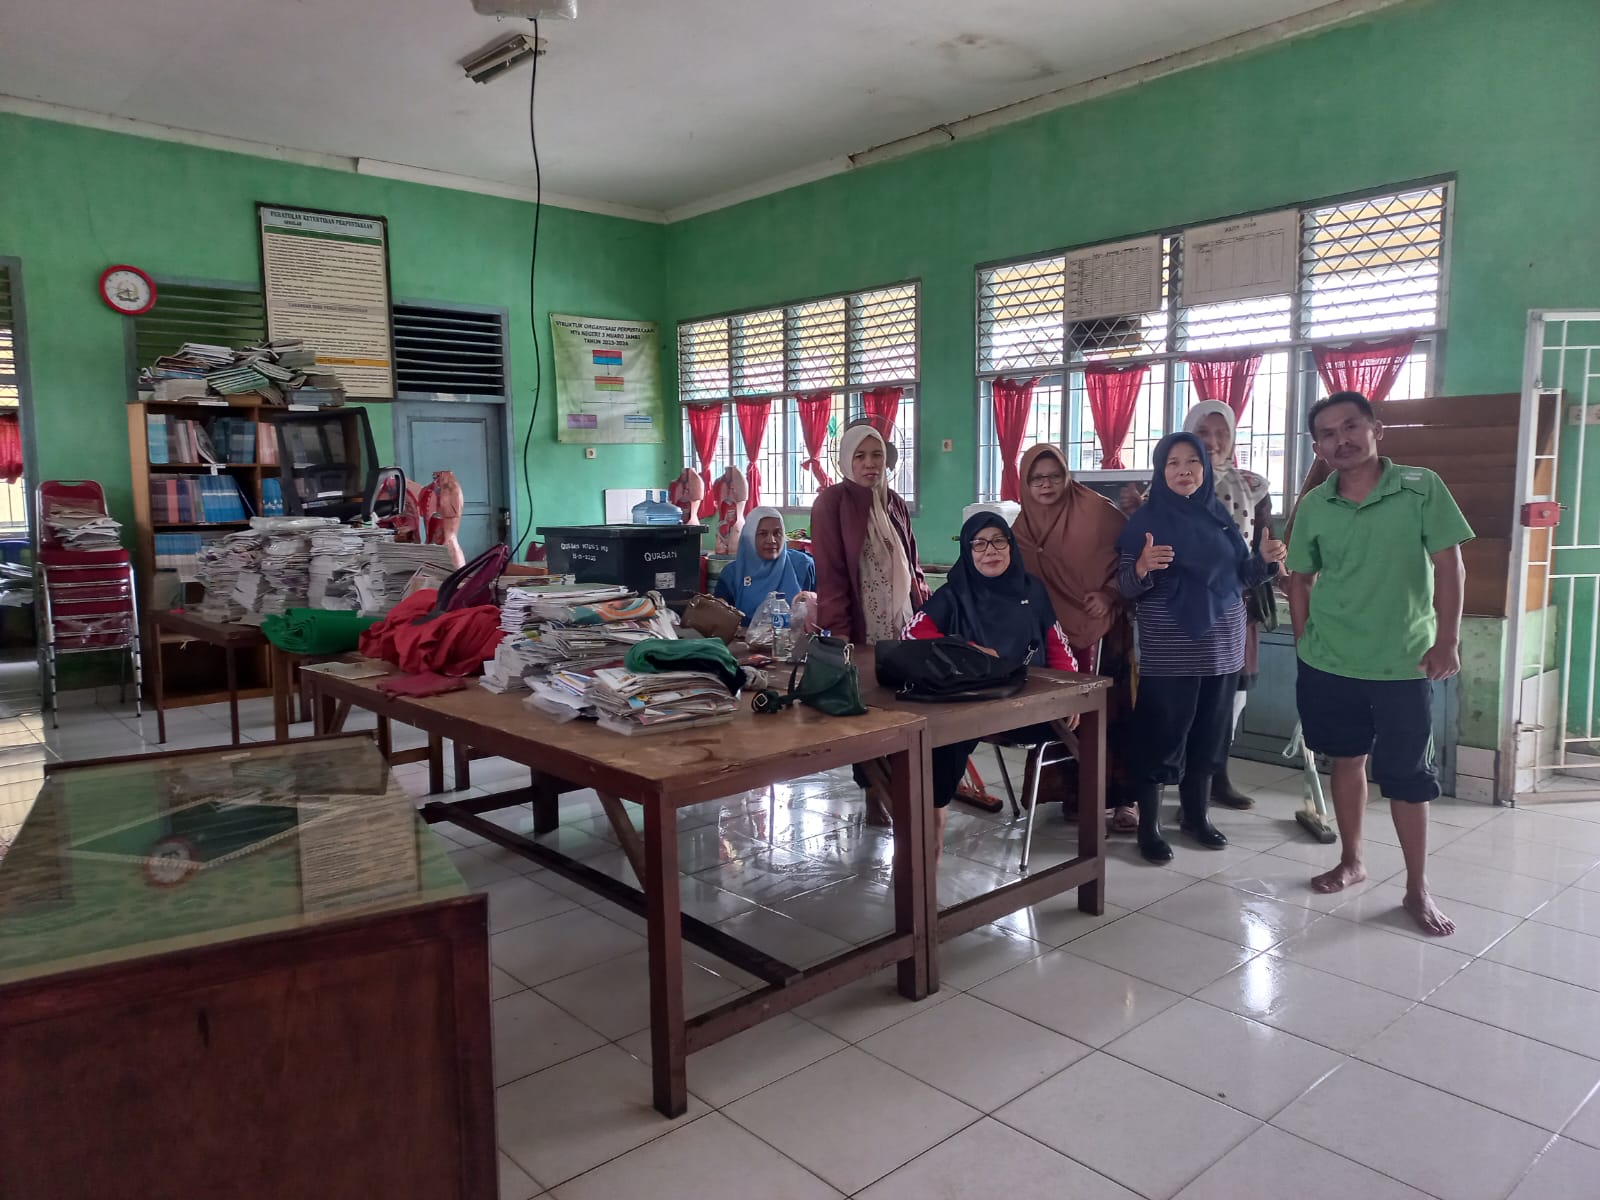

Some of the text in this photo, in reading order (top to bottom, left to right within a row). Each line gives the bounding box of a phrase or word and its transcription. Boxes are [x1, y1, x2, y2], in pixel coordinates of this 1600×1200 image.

[556, 320, 584, 328] STRUKTUR
[584, 323, 617, 331] ORGANISASI
[644, 551, 677, 562] QURBAN
